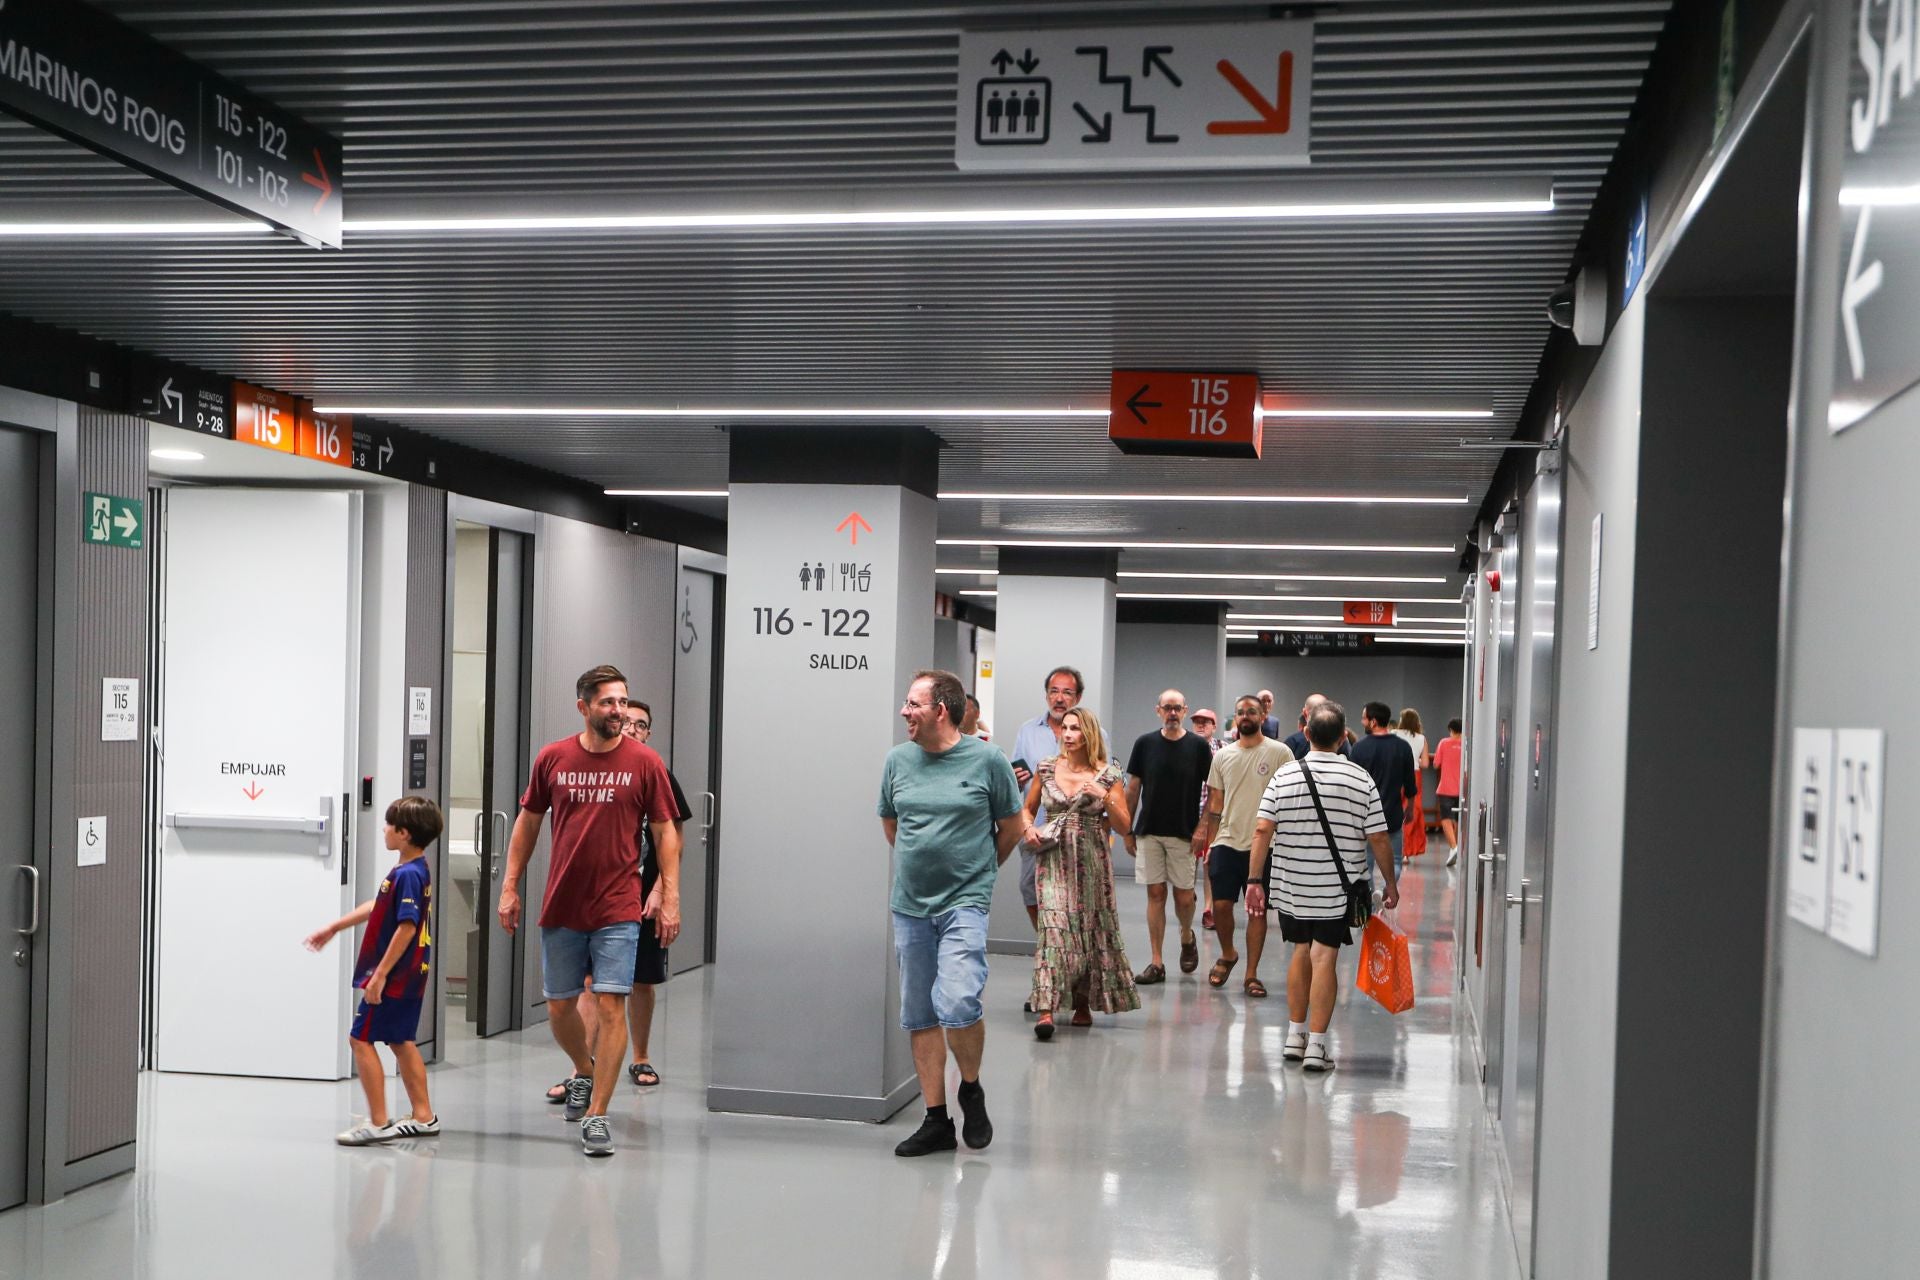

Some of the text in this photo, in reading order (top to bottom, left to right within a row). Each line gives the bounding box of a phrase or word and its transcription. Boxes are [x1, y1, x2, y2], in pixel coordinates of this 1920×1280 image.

[1851, 0, 1920, 153] SA
[0, 39, 185, 154] MARINOS ROIG
[216, 94, 242, 136] 115
[258, 116, 288, 160] 122
[215, 145, 243, 188] 101
[258, 166, 288, 206] 103
[1191, 378, 1229, 406] 115
[197, 412, 204, 428] 9
[211, 415, 224, 433] 28
[252, 403, 281, 445] 115
[1188, 408, 1228, 436] 116
[314, 420, 340, 459] 116
[360, 452, 366, 467] 8
[753, 607, 794, 636] 116
[821, 608, 870, 637] 122
[1370, 612, 1384, 623] 117
[809, 653, 869, 671] SALIDA
[114, 693, 128, 709] 115
[416, 698, 425, 711] 116
[221, 762, 286, 776] EMPUJAR
[557, 771, 632, 786] MOUNTAIN
[569, 788, 615, 803] THYME
